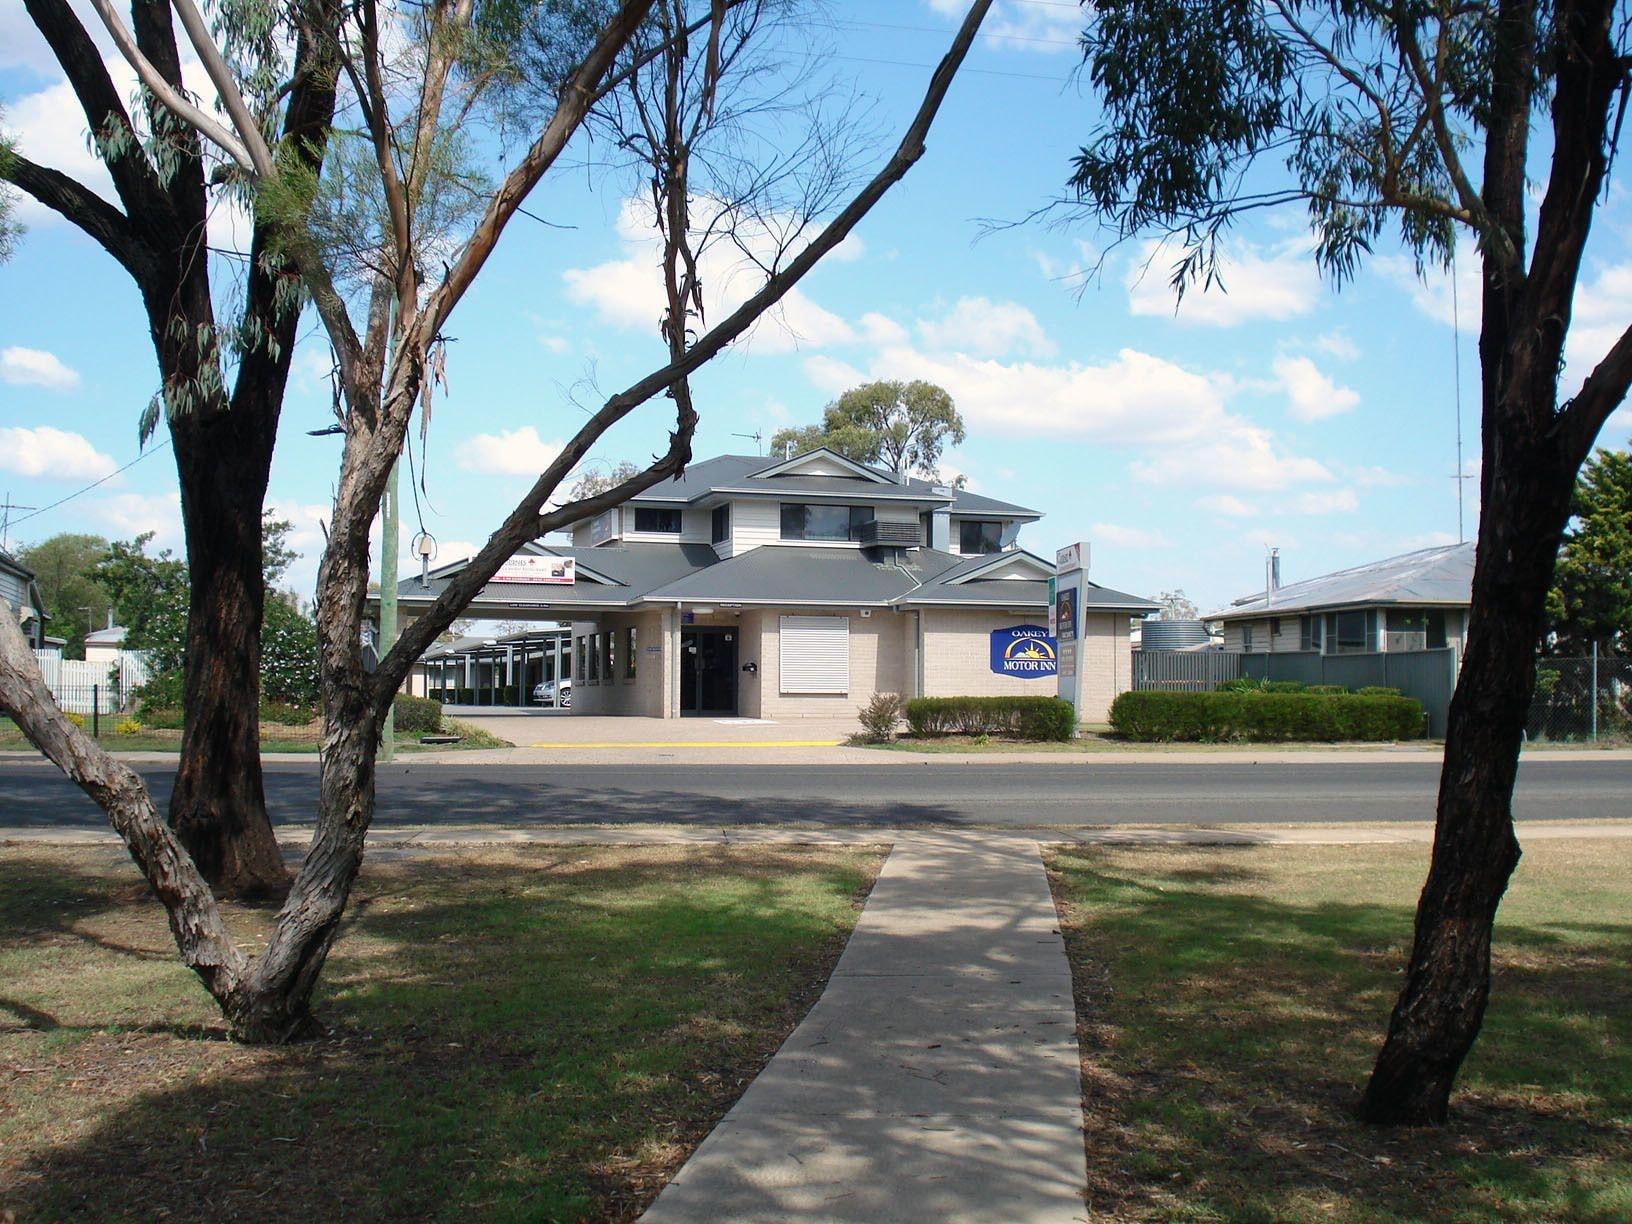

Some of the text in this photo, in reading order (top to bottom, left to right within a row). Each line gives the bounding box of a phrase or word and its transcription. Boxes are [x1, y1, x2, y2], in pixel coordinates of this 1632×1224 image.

[1011, 630, 1048, 638] OAKEY
[1003, 660, 1039, 671] MOTOR
[1040, 661, 1057, 671] INN
